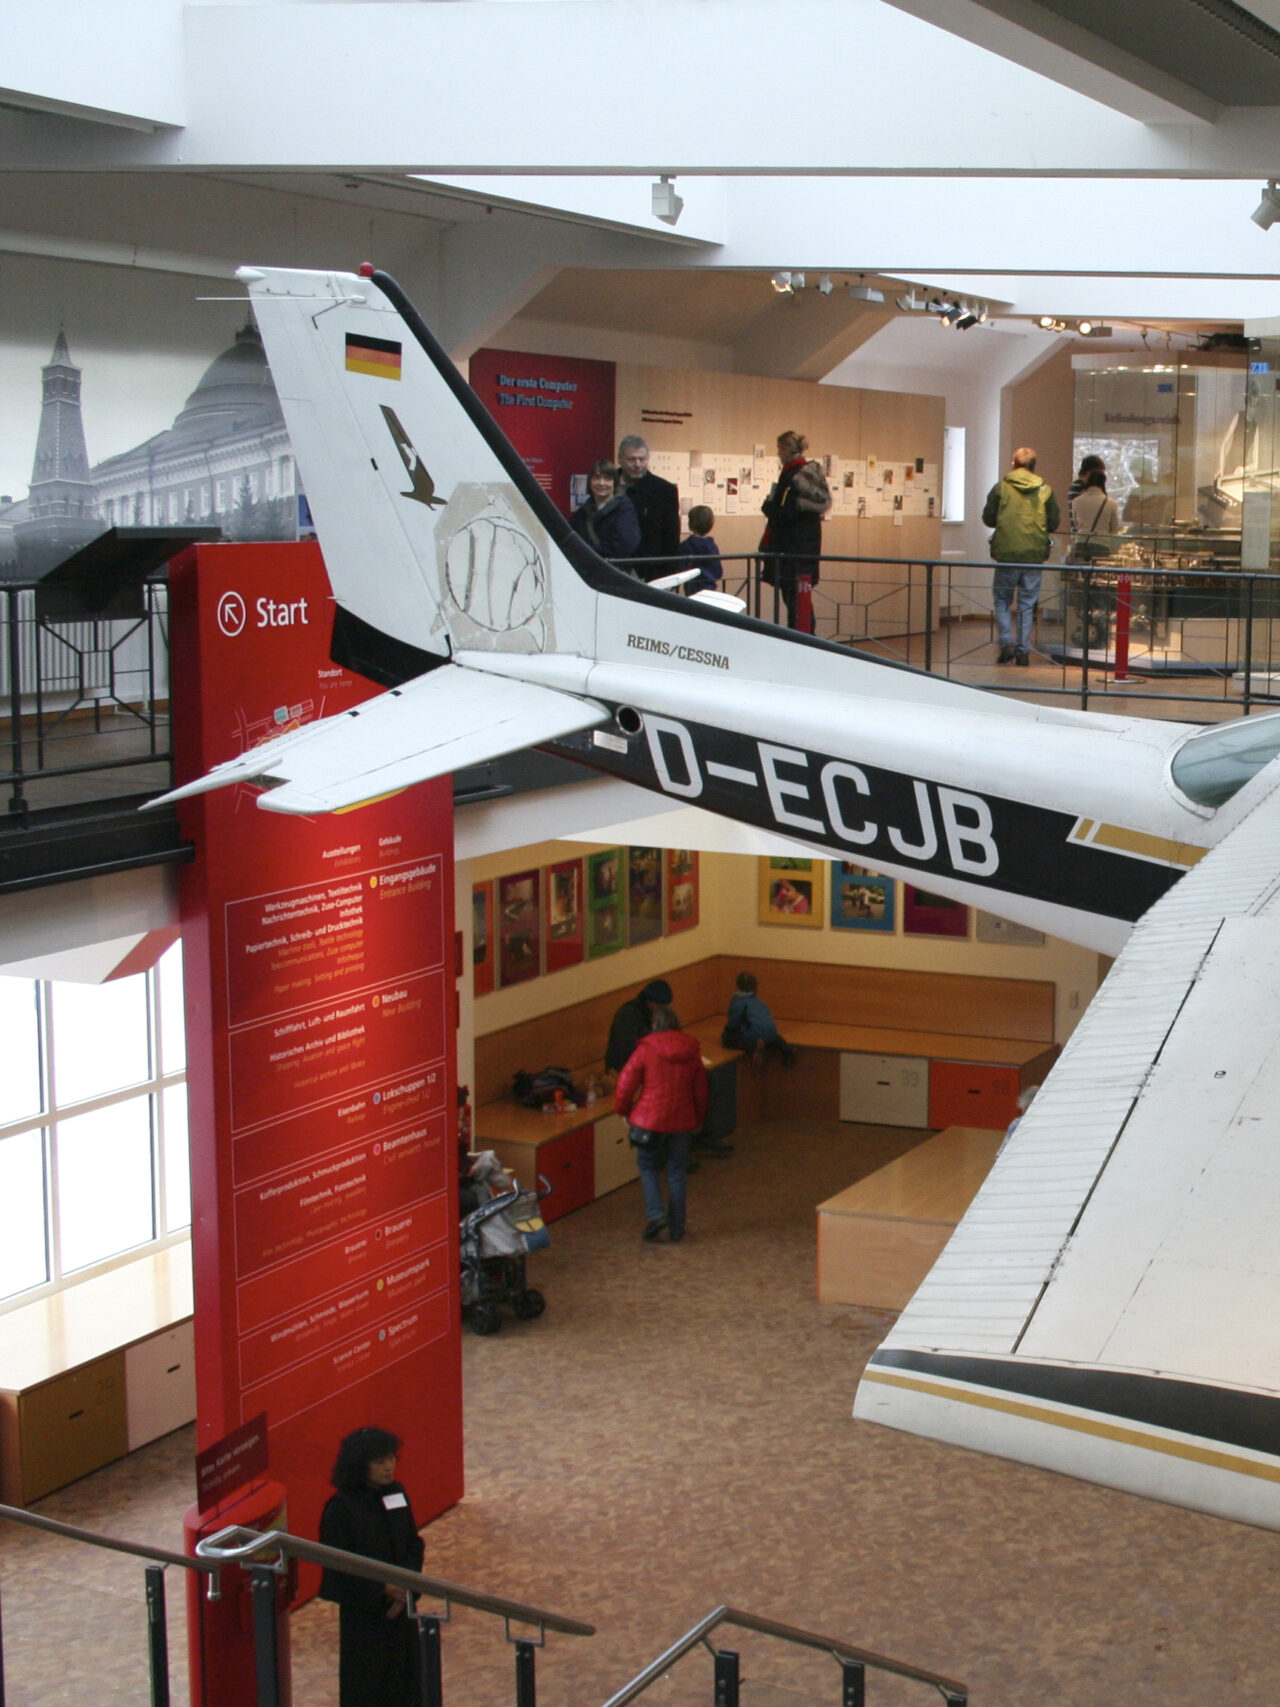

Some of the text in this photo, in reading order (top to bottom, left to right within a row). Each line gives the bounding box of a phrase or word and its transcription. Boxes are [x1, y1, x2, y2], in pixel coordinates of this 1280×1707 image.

[499, 374, 515, 386] Der
[539, 376, 578, 392] Computer
[536, 395, 574, 410] Computer
[256, 598, 308, 628] Start
[626, 634, 730, 670] REIMS/CESSNA
[318, 668, 342, 678] Standort
[643, 712, 1000, 878] D-ECJB
[382, 990, 408, 1004] Neubau
[383, 1078, 426, 1101] Lokschuppen
